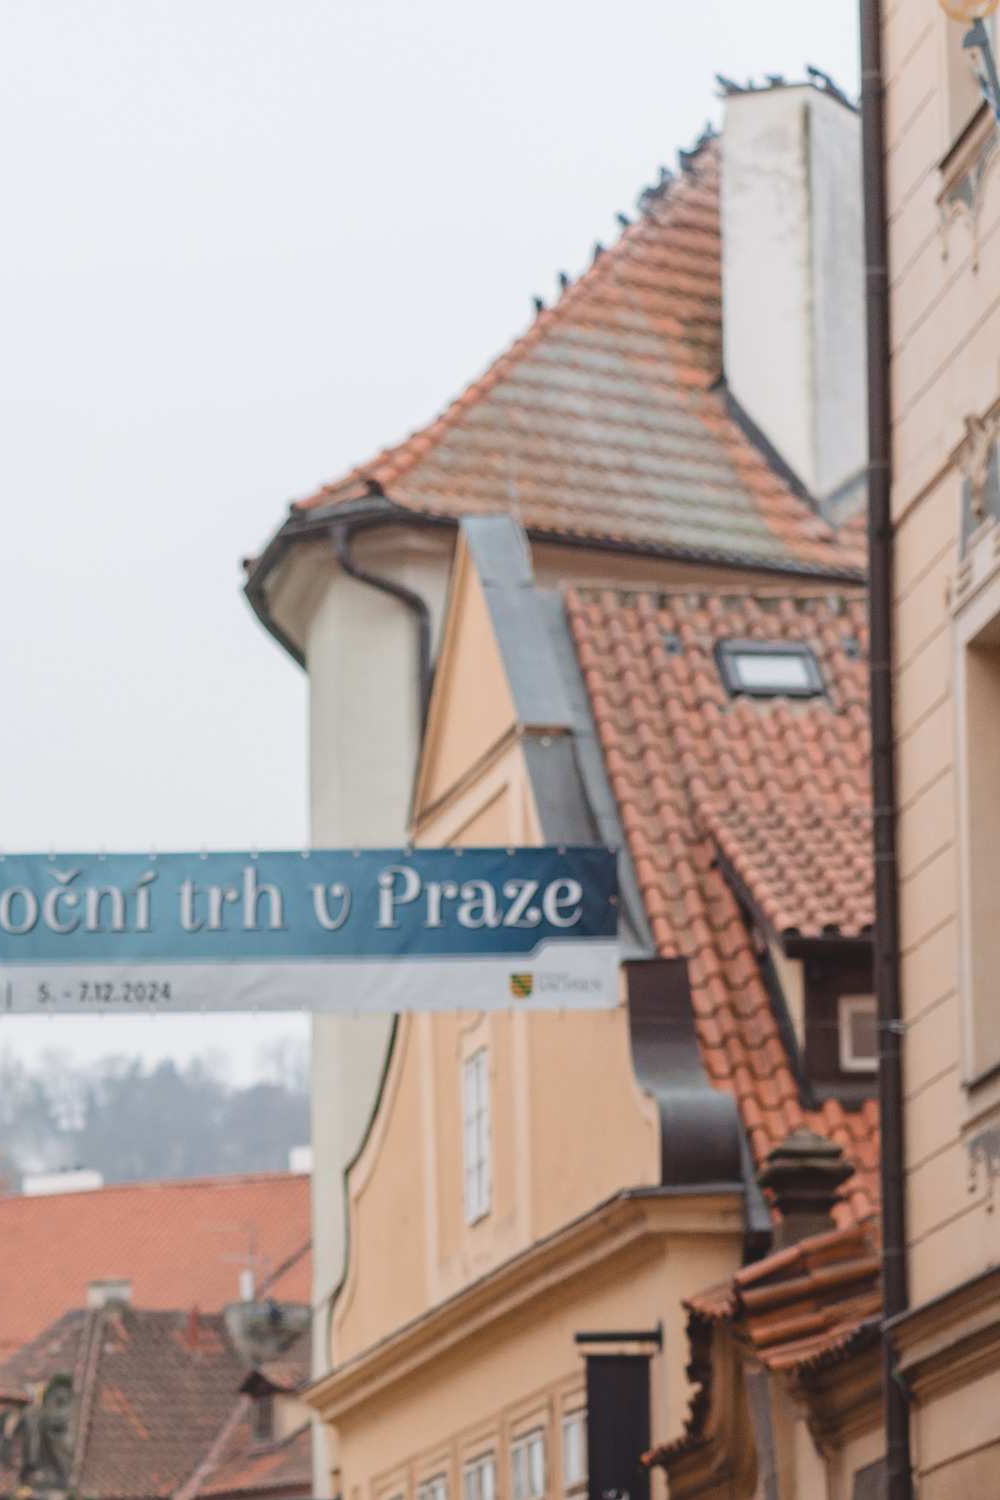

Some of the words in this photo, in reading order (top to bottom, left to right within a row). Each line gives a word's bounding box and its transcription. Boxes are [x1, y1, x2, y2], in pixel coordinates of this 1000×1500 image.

[180, 866, 287, 931] trh
[308, 882, 352, 931] v
[376, 864, 584, 929] Praze
[79, 980, 172, 1004] 7.12.2024
